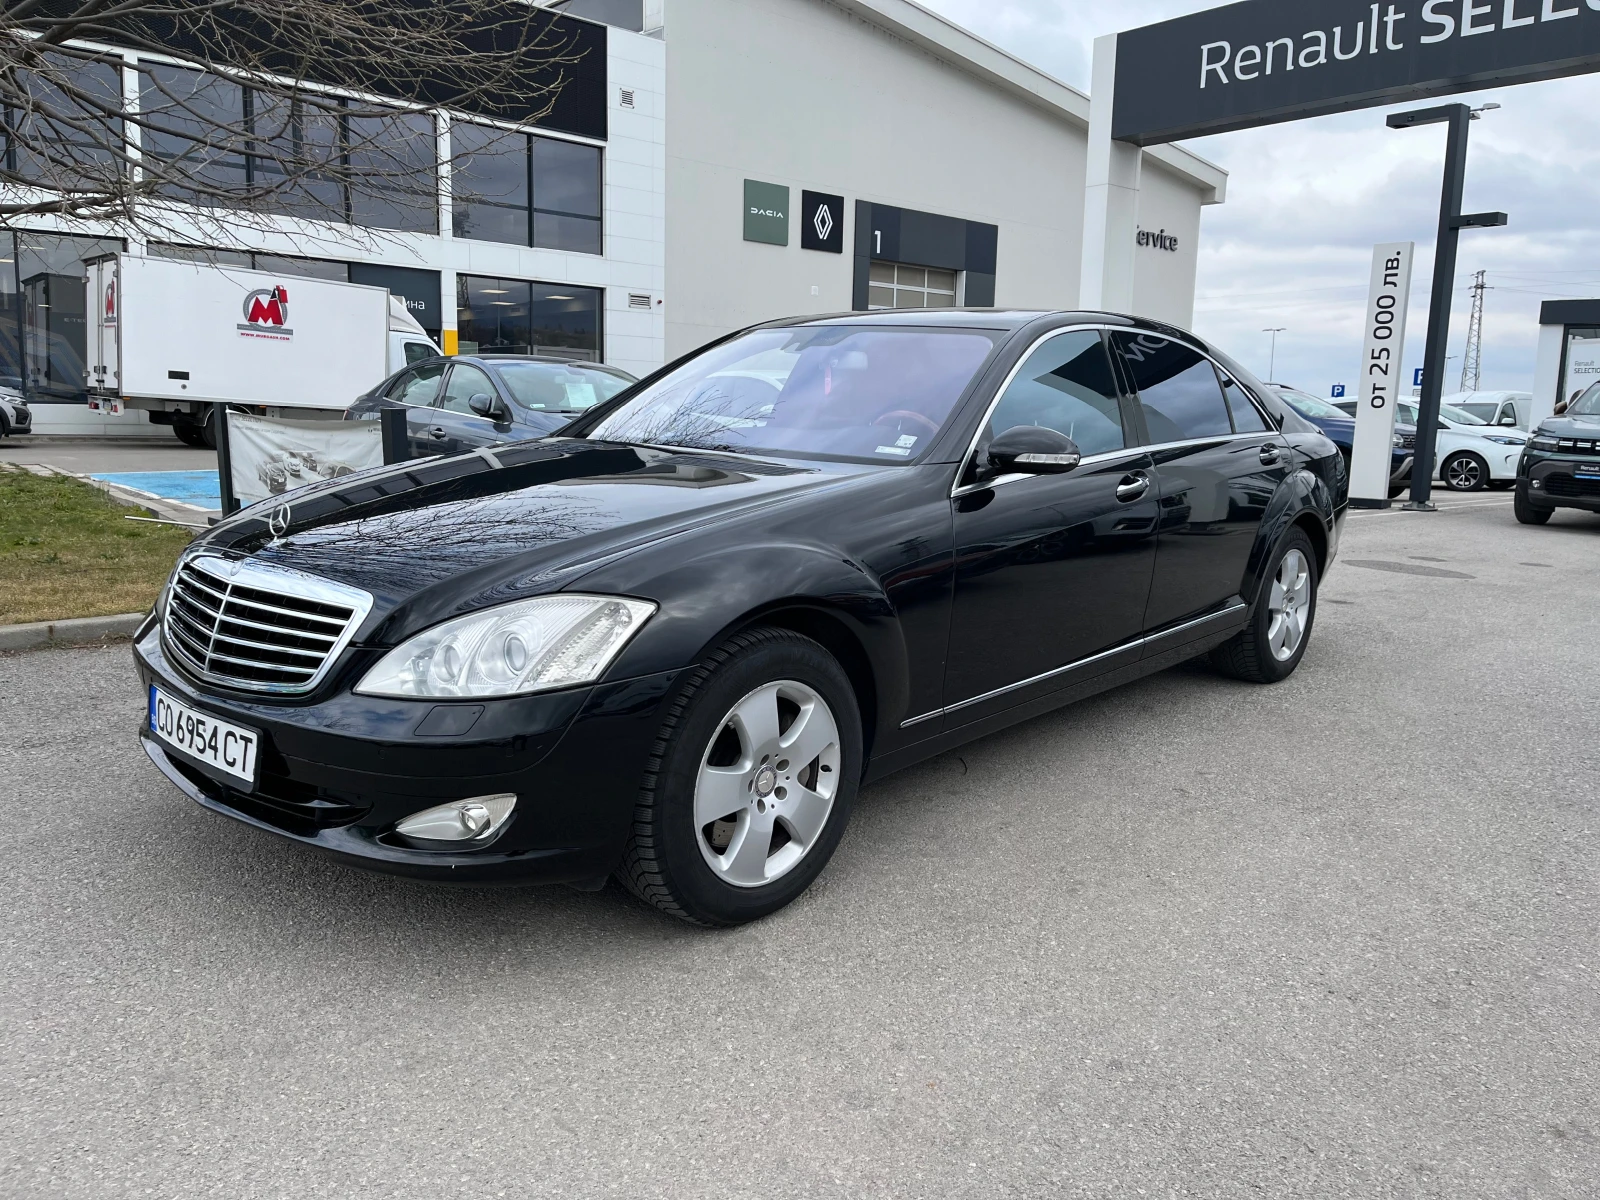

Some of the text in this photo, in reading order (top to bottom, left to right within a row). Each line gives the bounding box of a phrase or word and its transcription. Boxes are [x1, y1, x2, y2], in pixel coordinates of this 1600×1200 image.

[1200, 0, 1600, 89] Renault SEL
[750, 207, 784, 219] DACIA
[874, 230, 882, 254] 1
[1135, 224, 1179, 252] ervice
[1383, 250, 1402, 288] лв.
[1372, 294, 1397, 341] 000
[1369, 347, 1391, 376] 25
[1334, 386, 1343, 396] P
